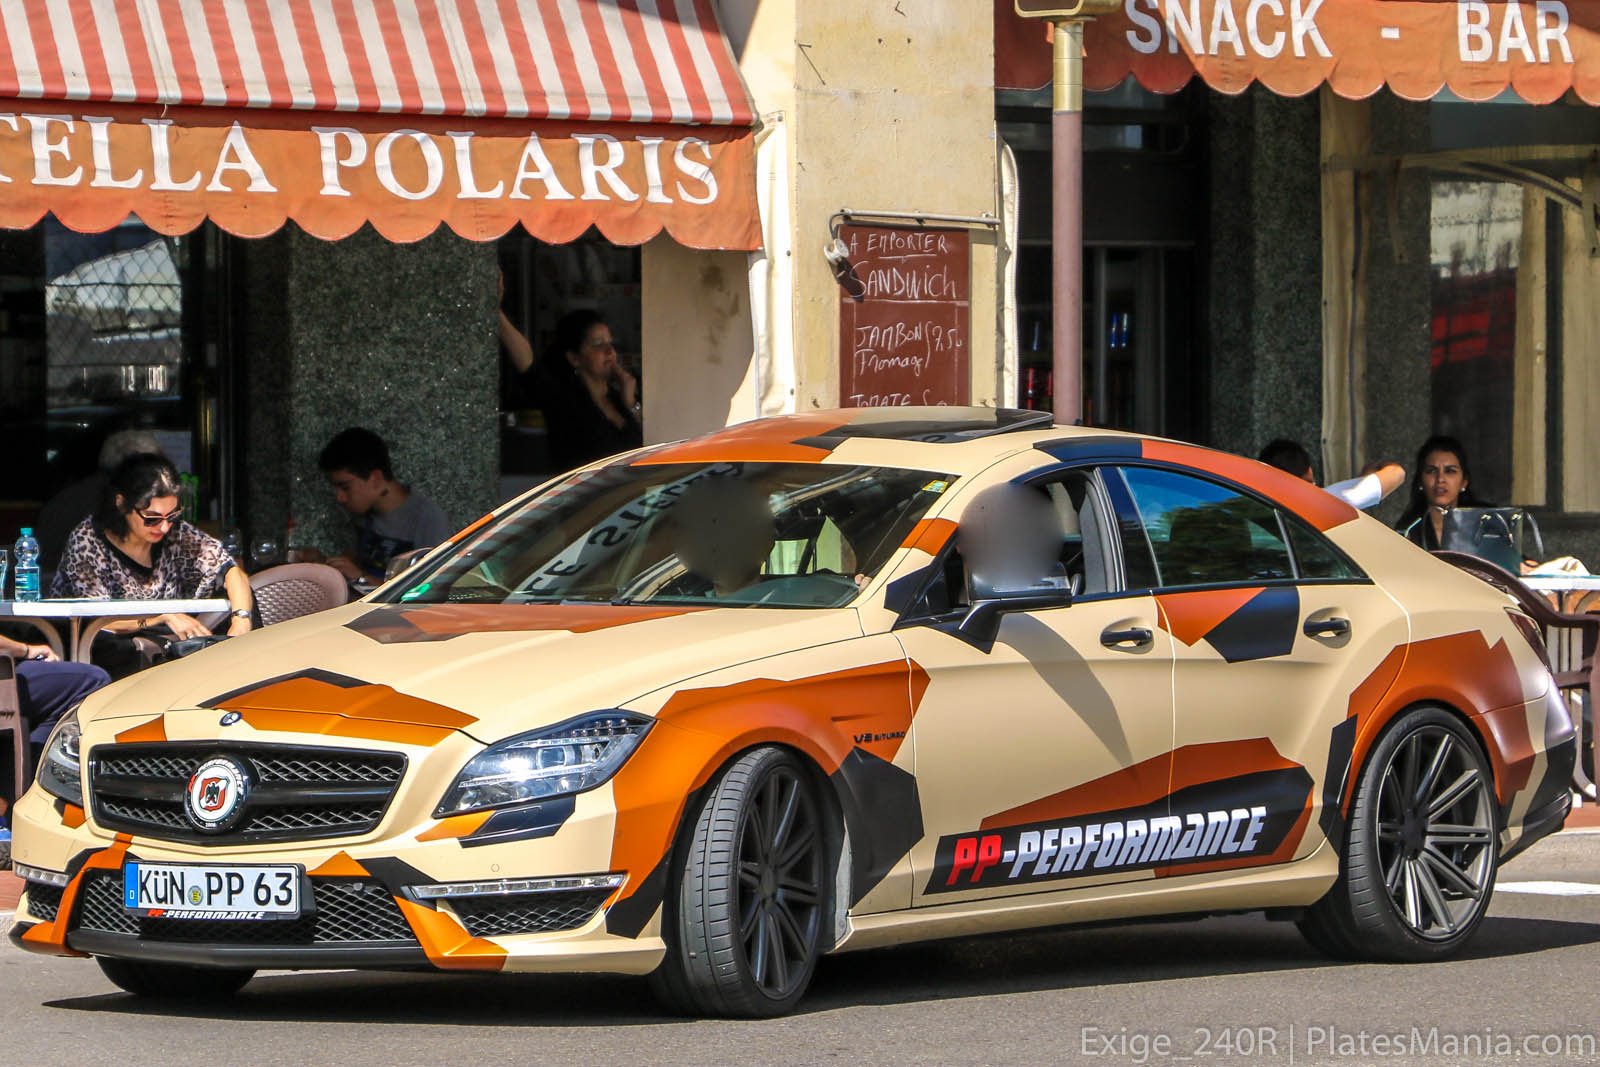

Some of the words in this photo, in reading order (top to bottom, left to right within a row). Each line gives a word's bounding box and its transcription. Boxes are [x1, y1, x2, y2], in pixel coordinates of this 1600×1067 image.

[1125, 0, 1334, 58] SNACK
[1457, 0, 1575, 63] BAR
[311, 125, 719, 205] POLARIS
[867, 231, 949, 254] EMPORTER
[946, 806, 1267, 885] PP-PERFORMANCE
[204, 872, 245, 906] PP
[253, 873, 293, 906] 63
[147, 909, 266, 920] PP-PERFORMANCE
